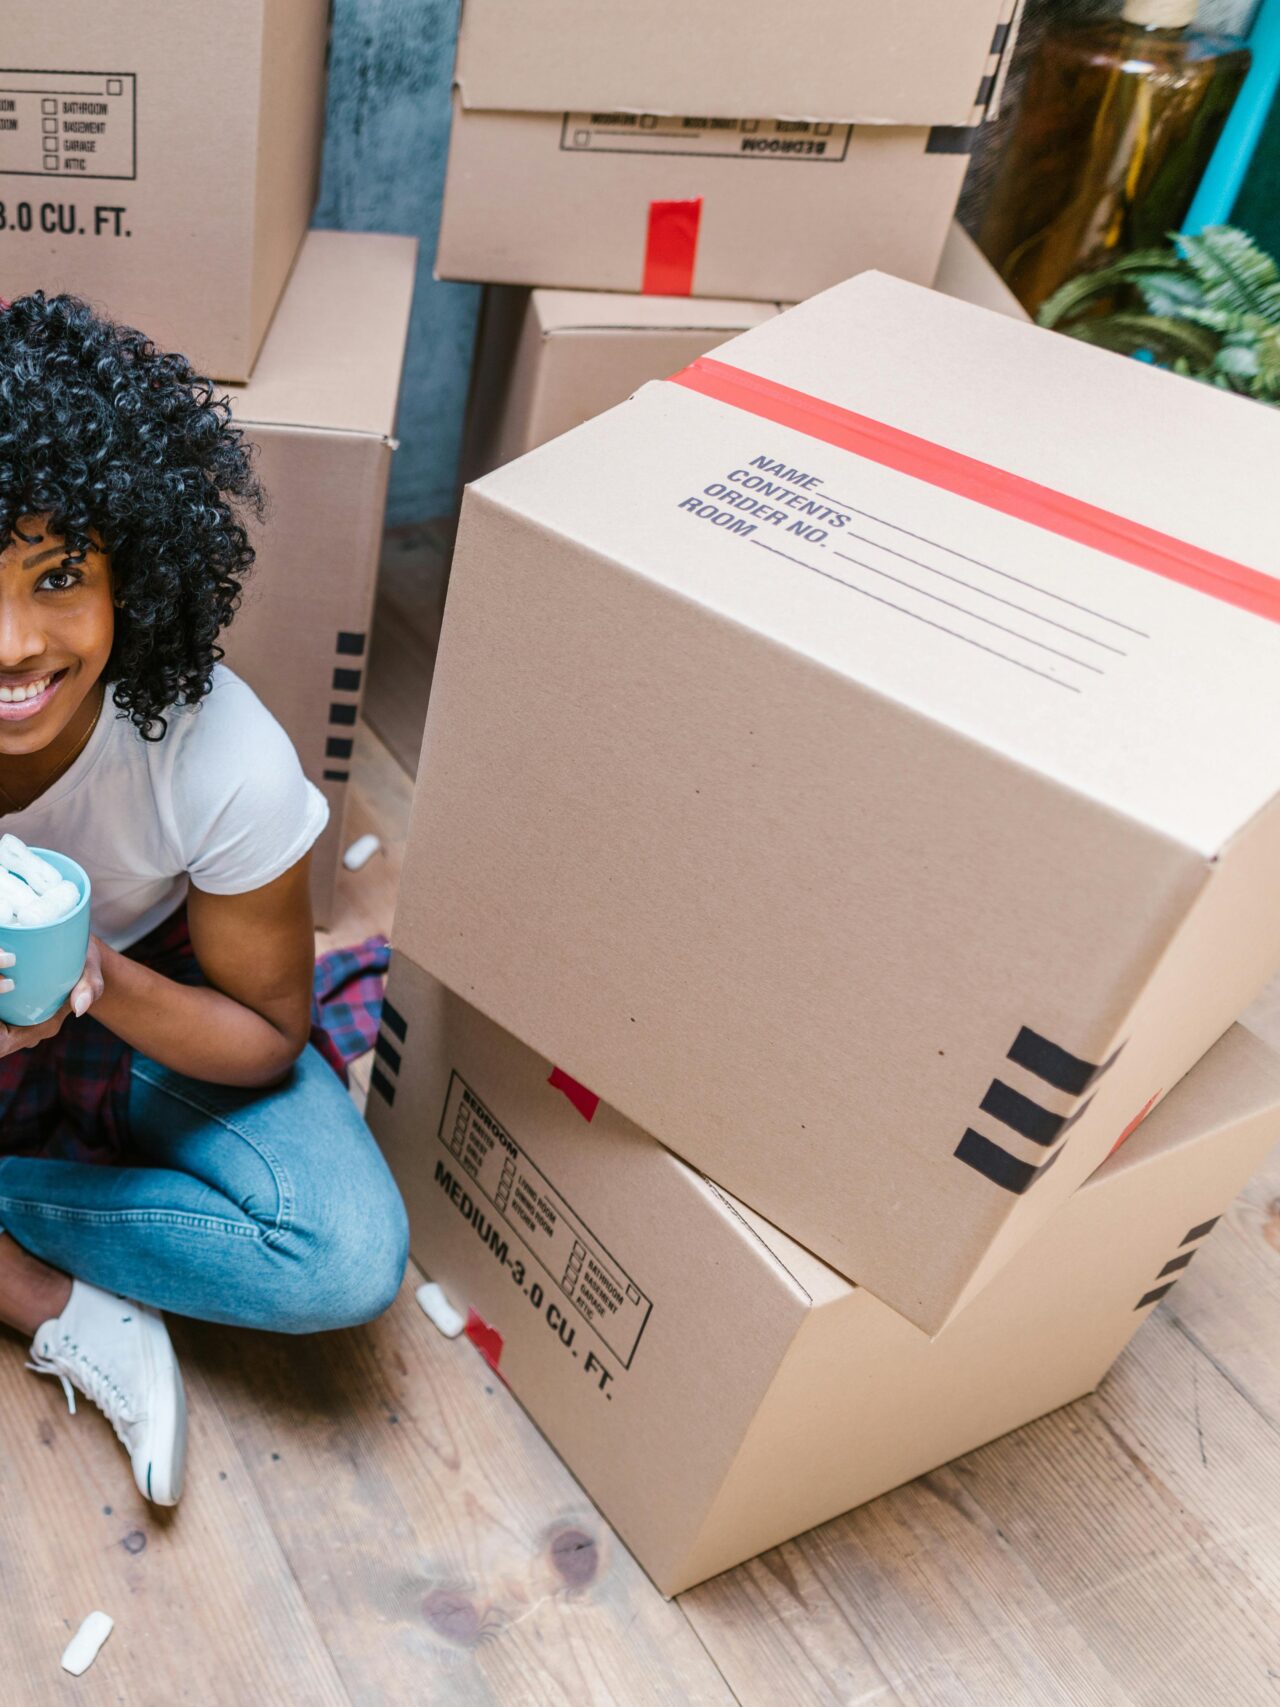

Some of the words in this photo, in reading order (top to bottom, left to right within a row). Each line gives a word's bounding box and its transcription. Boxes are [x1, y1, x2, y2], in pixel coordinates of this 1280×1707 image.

[62, 101, 108, 115] BATHROOM
[740, 137, 827, 154] BEDROOM
[40, 202, 85, 235] CU.
[94, 206, 132, 237] FT.
[749, 455, 824, 491] NAME
[677, 496, 758, 538] ROOM
[703, 483, 789, 526] ORDER
[785, 520, 829, 548] NO.
[726, 469, 852, 528] CONTENTS
[463, 1089, 518, 1160] BEDROOM
[433, 1160, 544, 1309] MEDIUM-3.0
[545, 1303, 578, 1357] CU.
[583, 1351, 614, 1400] FT.
[588, 1260, 624, 1305] BATHROOM
